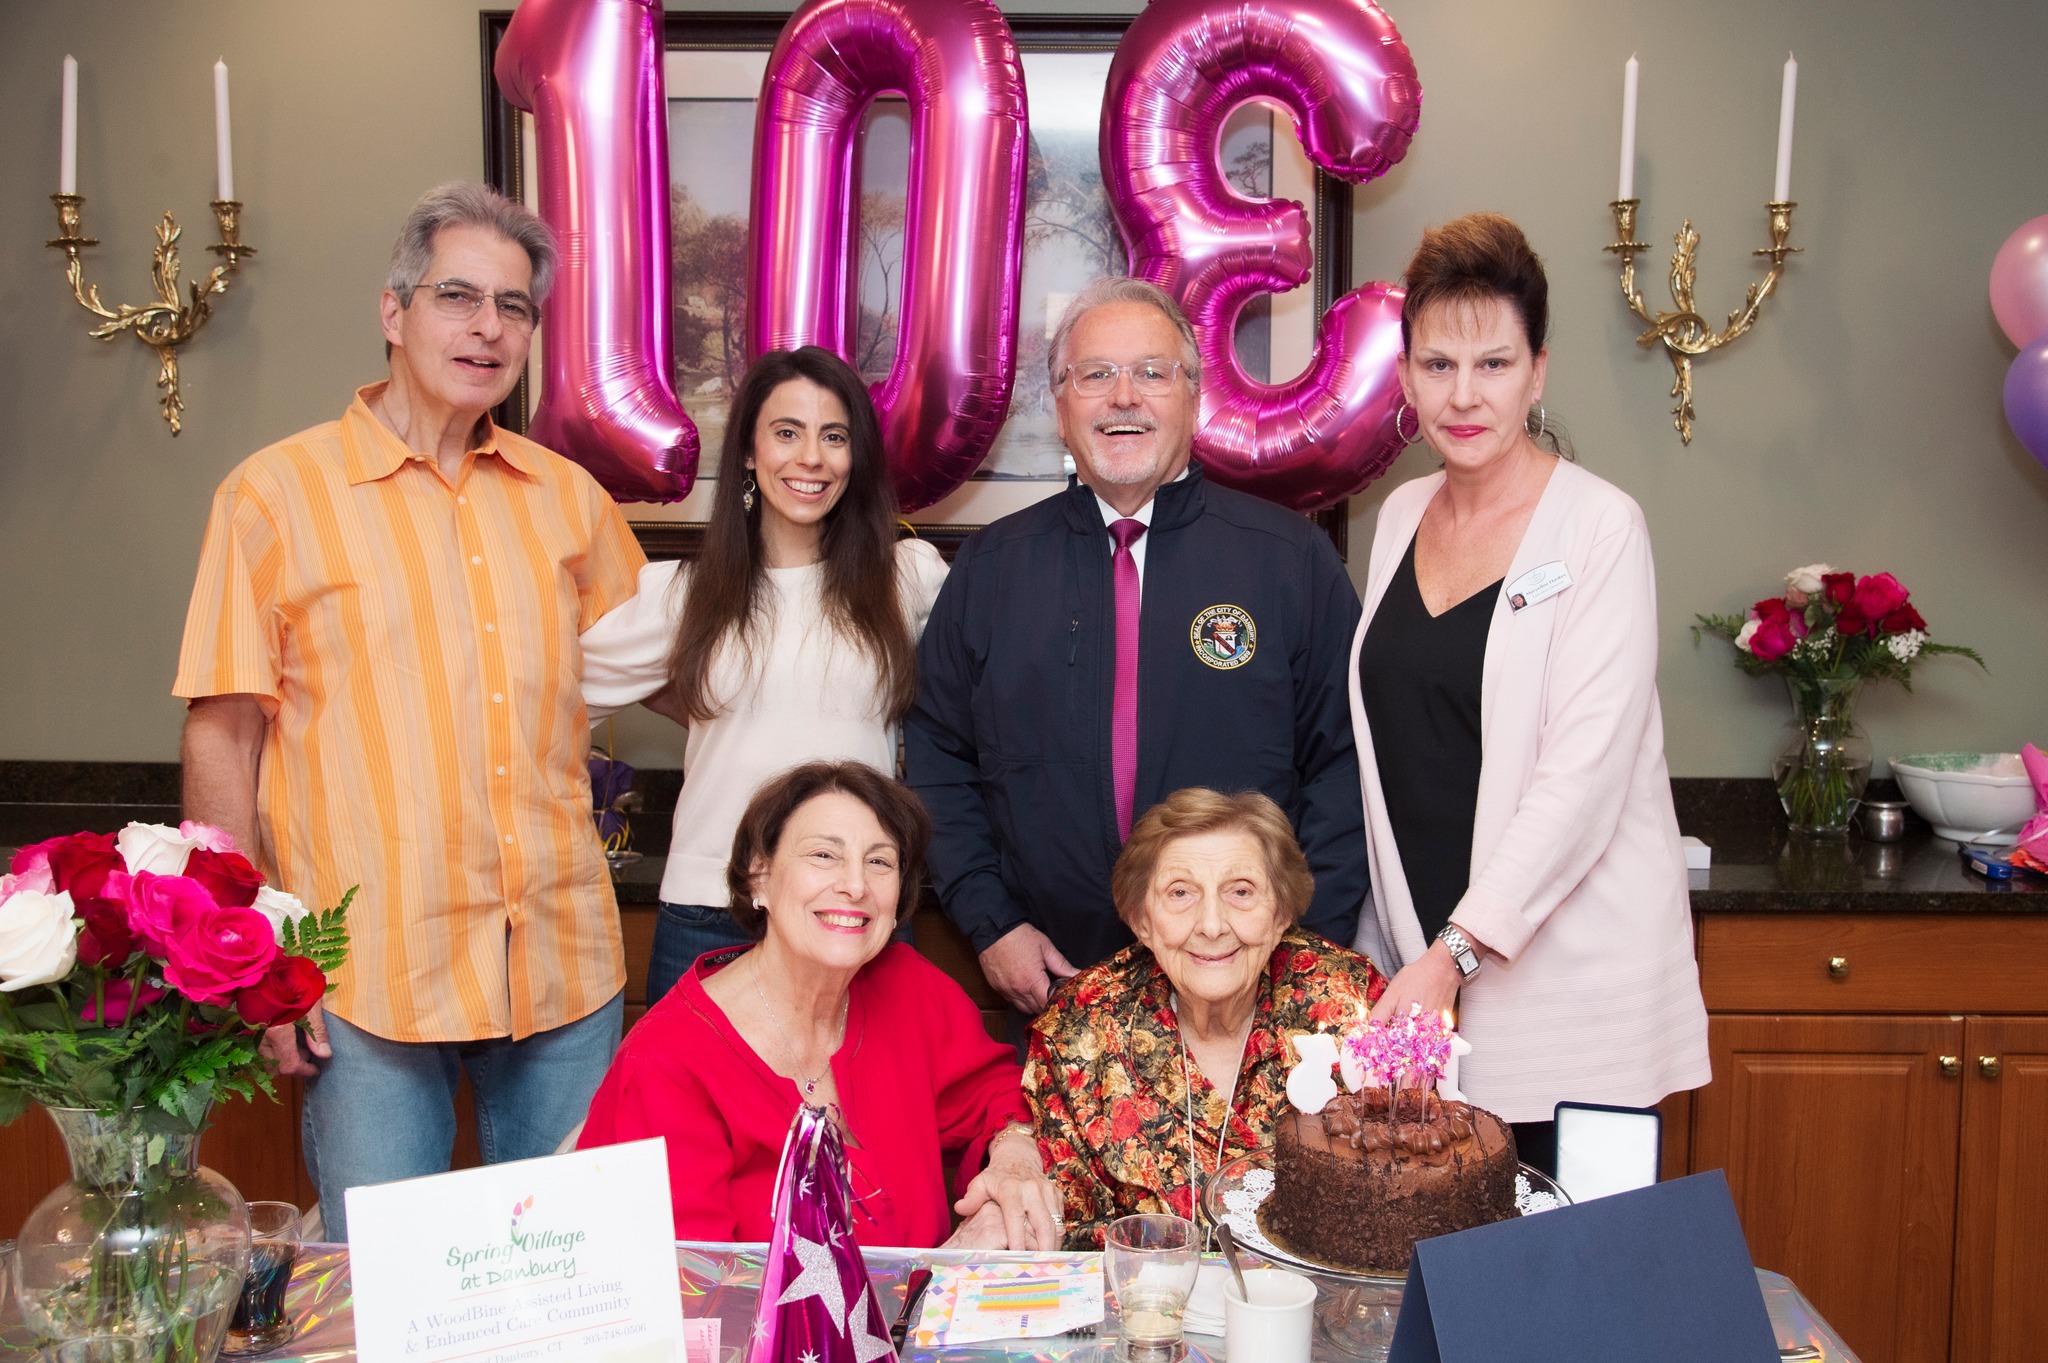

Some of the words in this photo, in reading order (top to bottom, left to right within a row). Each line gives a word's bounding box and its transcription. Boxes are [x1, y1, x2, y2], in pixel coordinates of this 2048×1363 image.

[1204, 608, 1216, 617] THE
[1232, 608, 1242, 616] OF
[1240, 614, 1255, 642] DANBURY
[1195, 644, 1239, 667] INCORPORATED
[446, 1243, 514, 1272] Spring
[521, 1230, 586, 1253] Village
[461, 1273, 481, 1291] at
[486, 1257, 577, 1279] Danbury
[407, 1319, 419, 1334] A
[425, 1304, 507, 1329] WoodBine
[512, 1287, 572, 1312] Assisted
[578, 1280, 624, 1299] Living
[405, 1339, 418, 1354] &
[426, 1320, 501, 1350] Enhanced
[506, 1316, 542, 1332] Care
[547, 1296, 632, 1323] Community
[547, 1341, 564, 1353] CT
[582, 1323, 648, 1346] 203-748-0506
